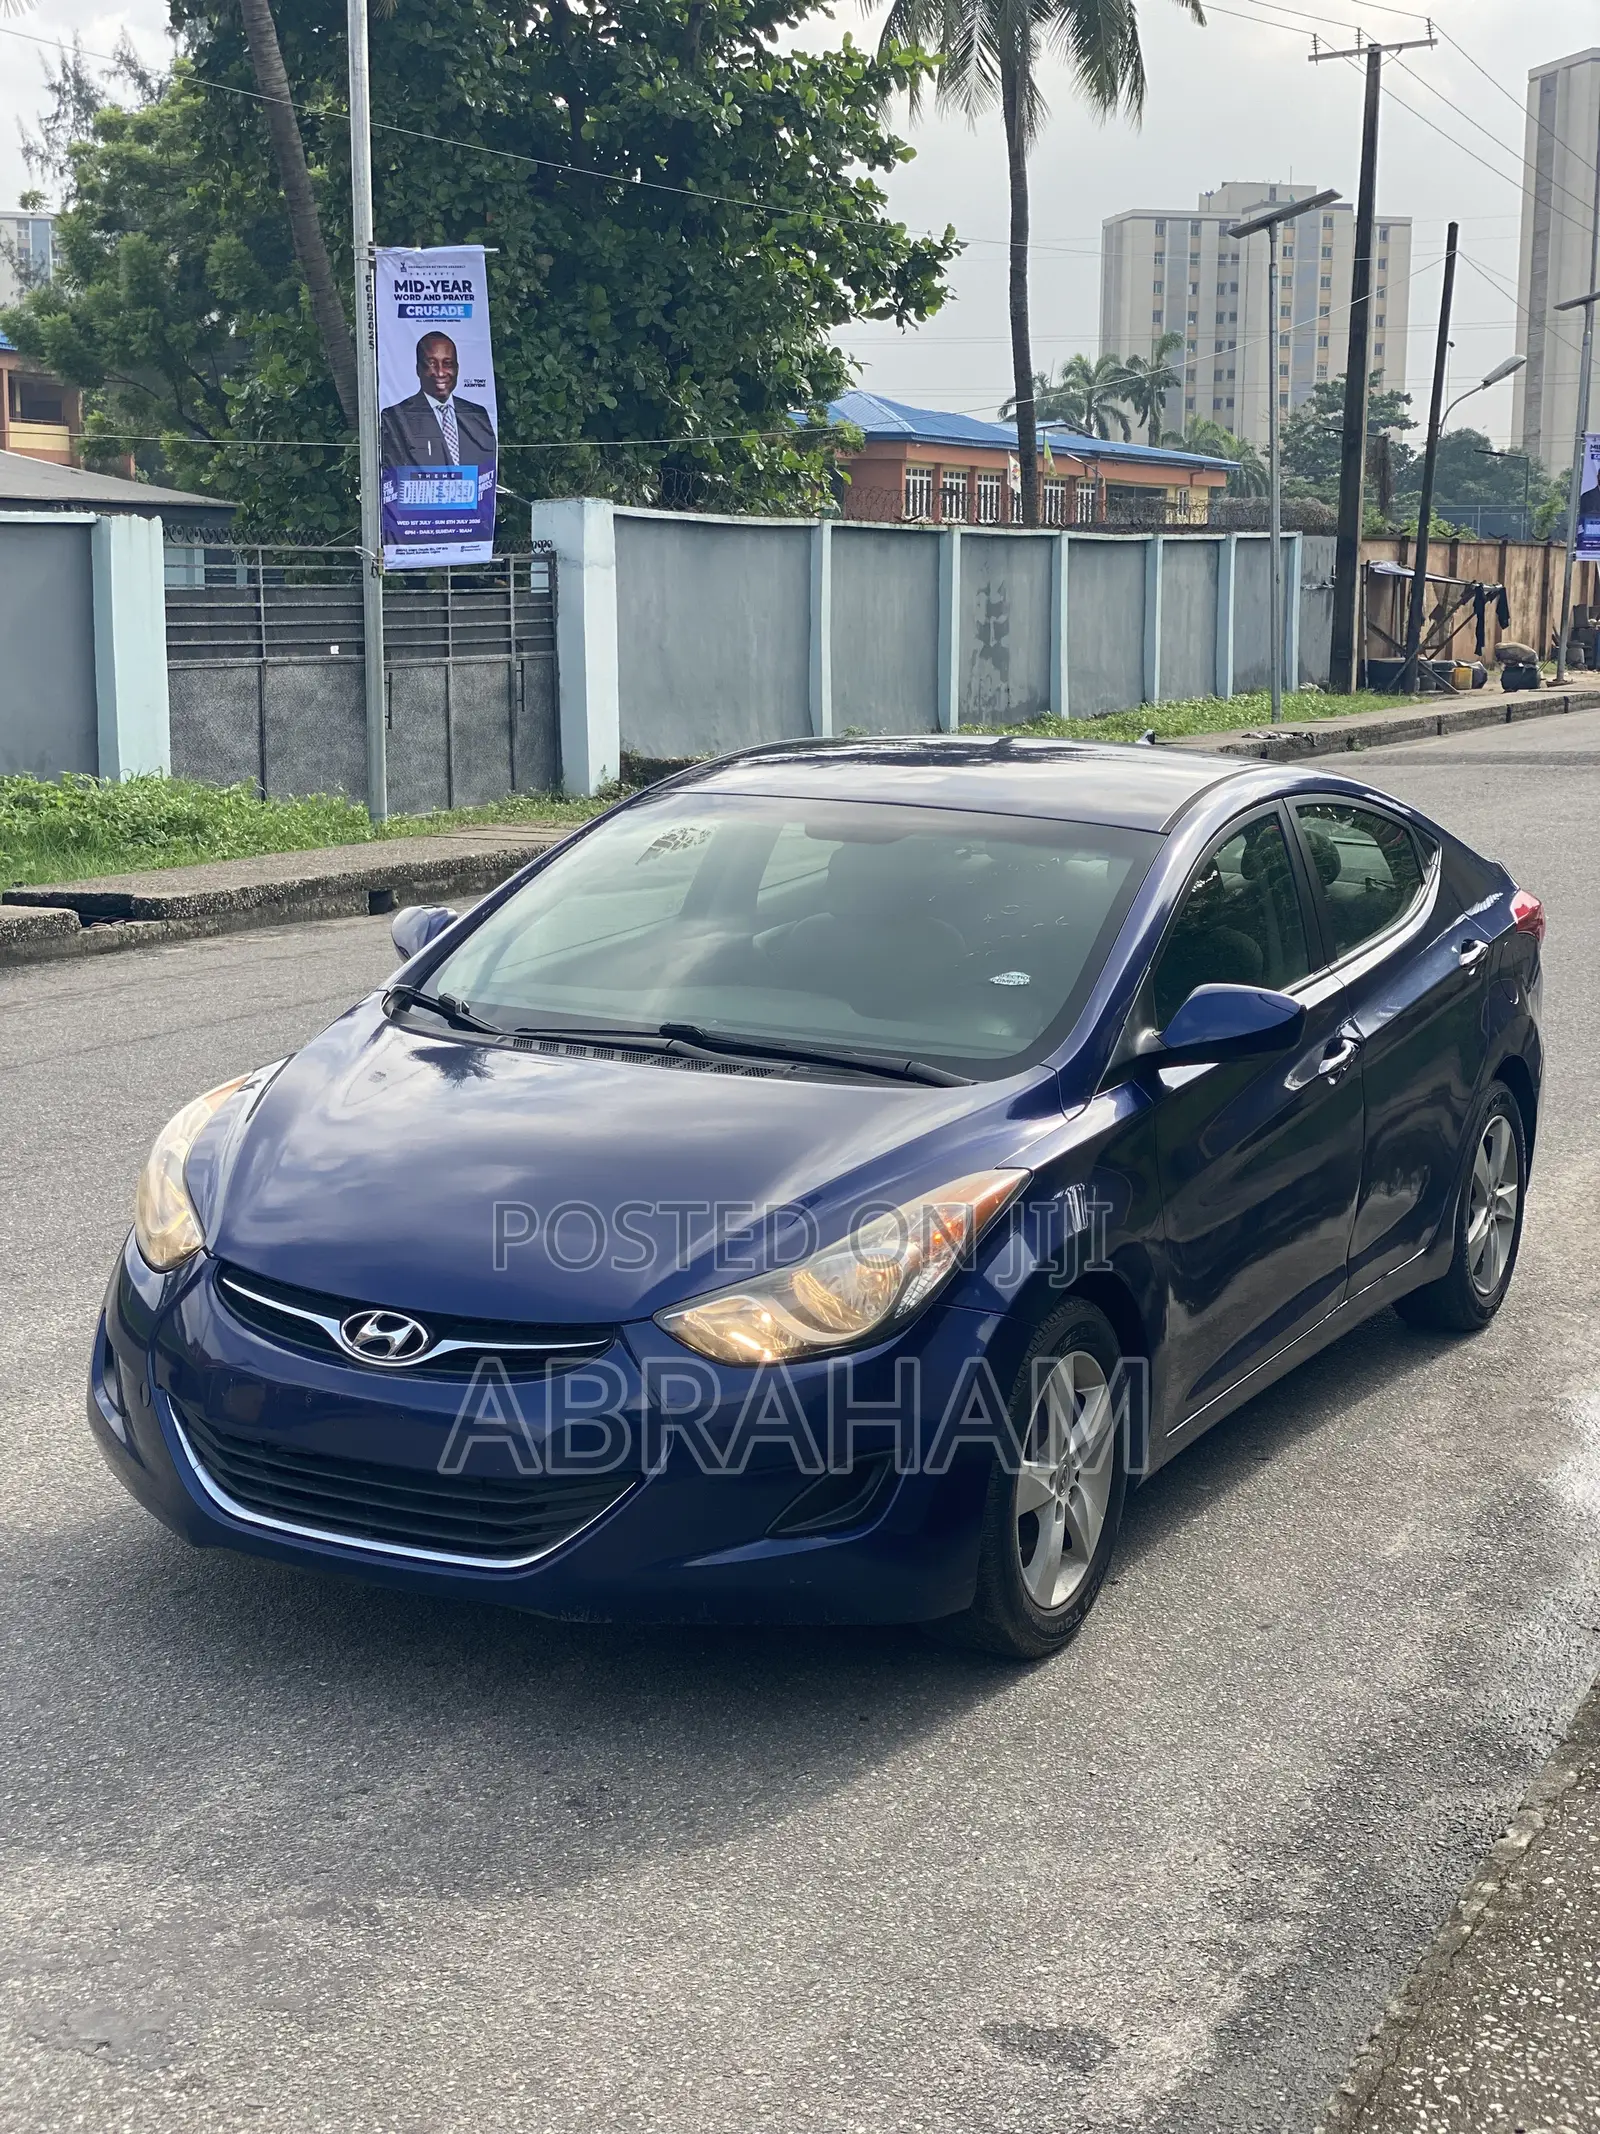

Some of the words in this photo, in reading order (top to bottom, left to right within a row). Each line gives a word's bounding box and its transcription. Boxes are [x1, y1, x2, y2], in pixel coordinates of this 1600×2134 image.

[394, 280, 472, 293] MID-YEAR
[406, 305, 465, 316] CRUSADE
[383, 480, 392, 489] SEE
[478, 491, 484, 501] IT
